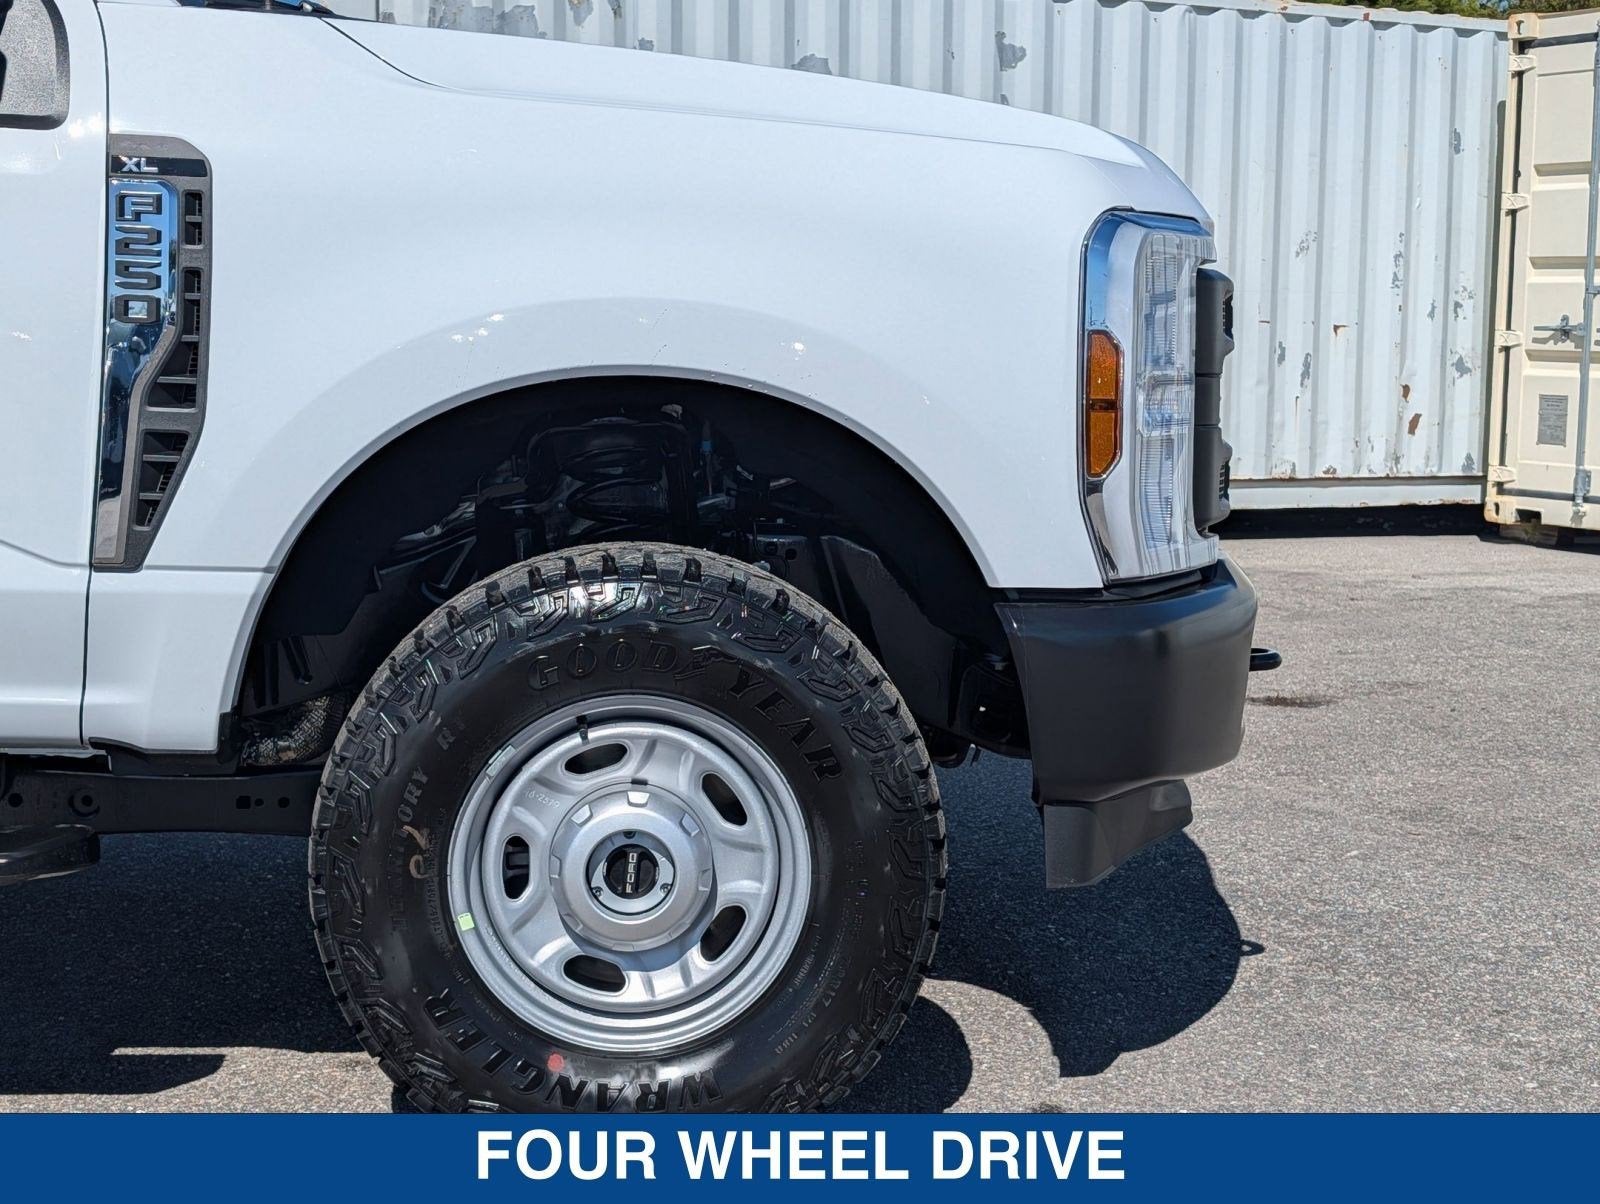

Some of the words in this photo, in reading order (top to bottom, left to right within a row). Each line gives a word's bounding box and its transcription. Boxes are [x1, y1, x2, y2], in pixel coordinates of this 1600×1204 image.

[119, 155, 158, 172] XL
[115, 190, 162, 325] F250
[626, 852, 637, 894] FORD
[424, 988, 723, 1113] WRANGLER
